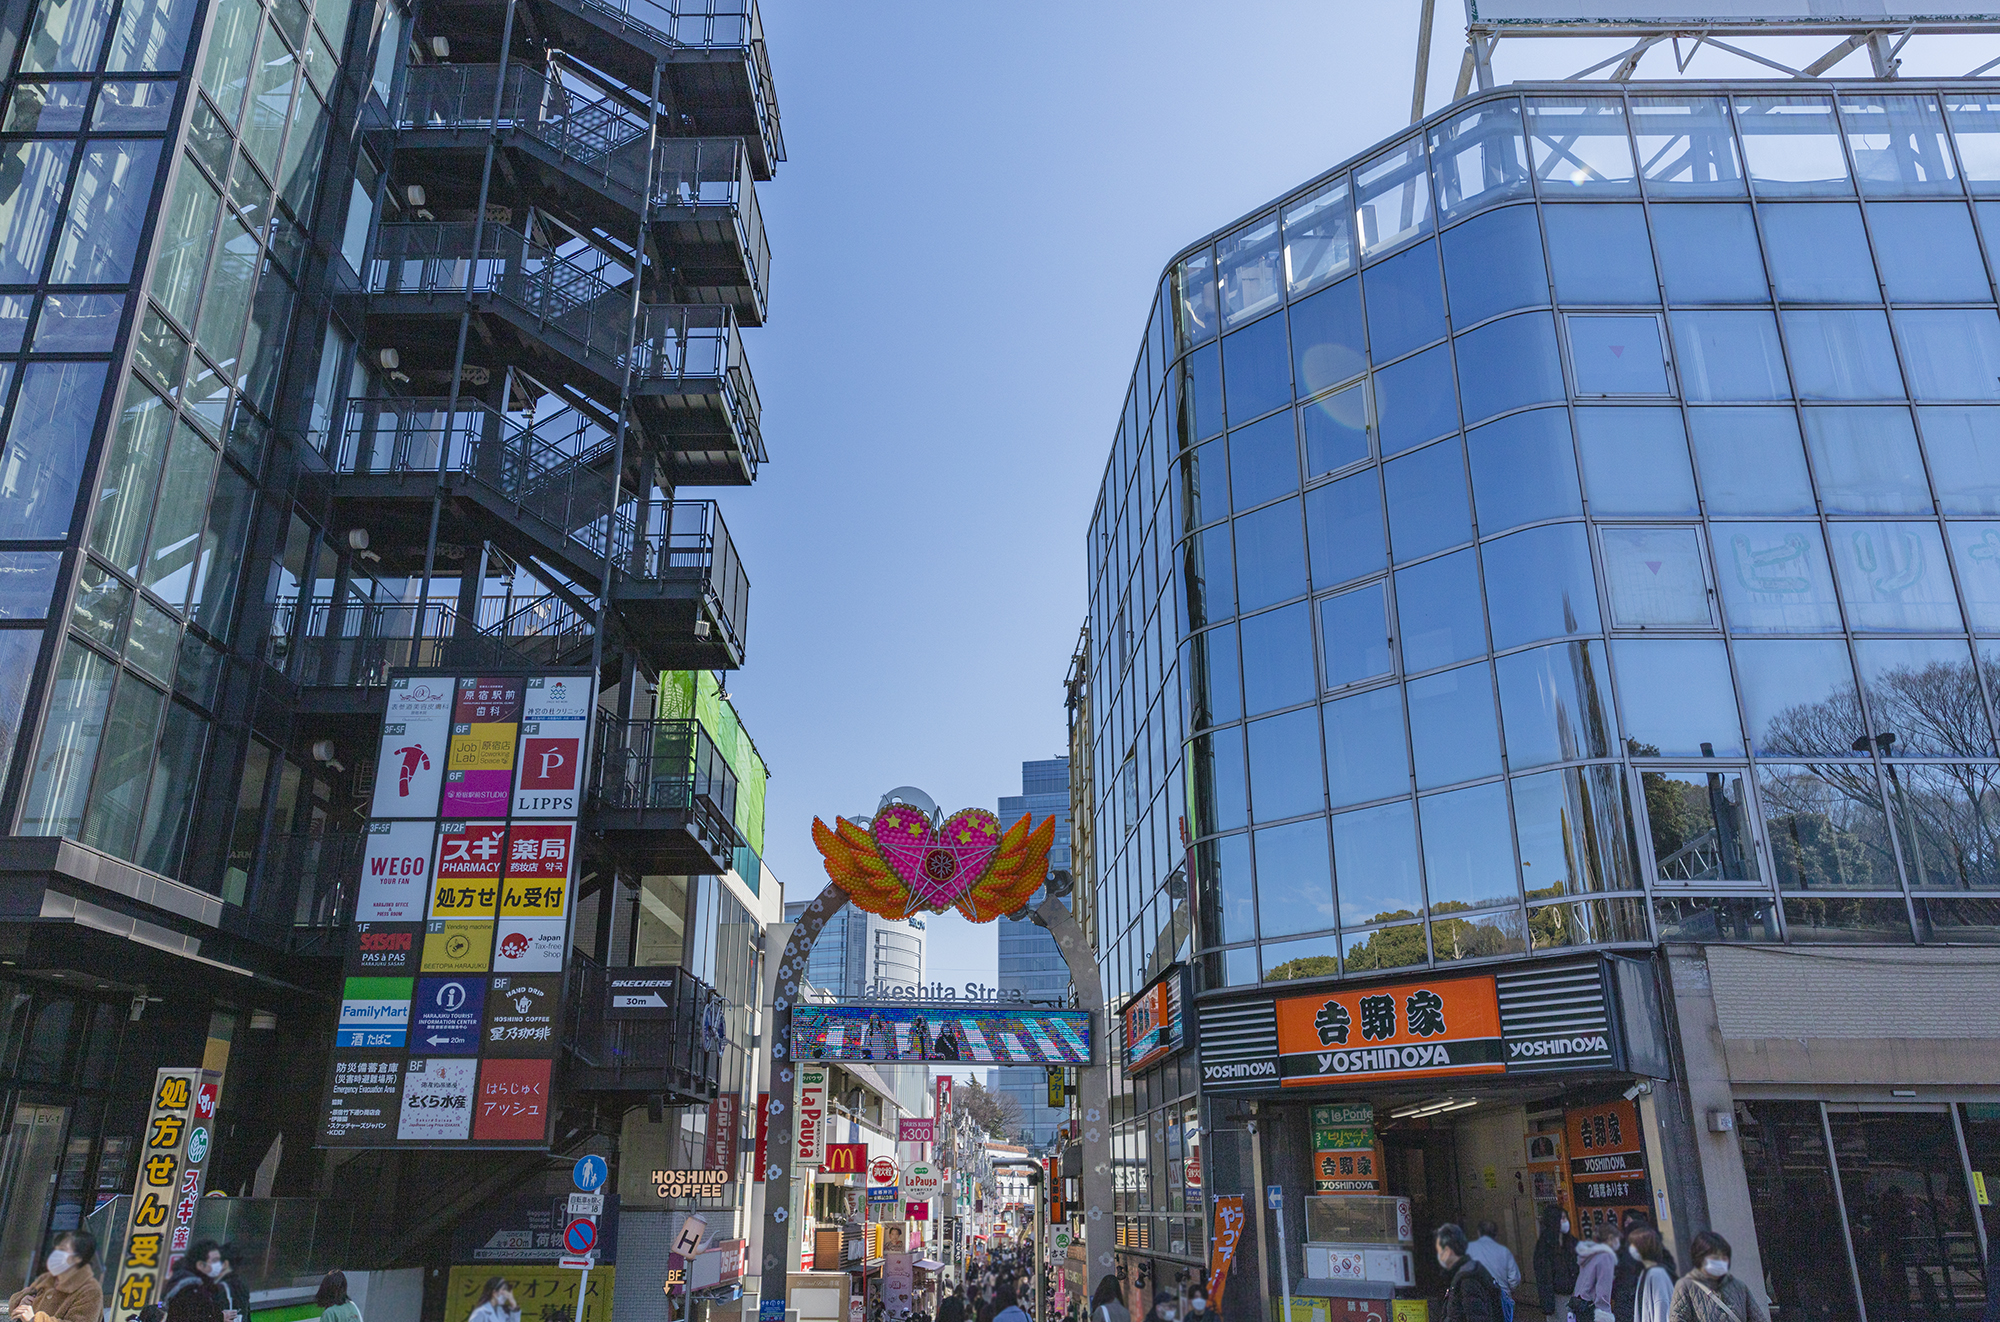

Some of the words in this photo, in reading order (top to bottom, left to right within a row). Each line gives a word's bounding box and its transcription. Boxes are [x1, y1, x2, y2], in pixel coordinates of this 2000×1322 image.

[394, 679, 406, 688] 7F
[462, 679, 474, 687] 7F
[530, 679, 542, 687] 7F
[464, 690, 515, 700] 原宿駅前
[476, 706, 500, 716] 歯科
[455, 725, 469, 733] 6F
[524, 725, 537, 733] 4F
[456, 743, 477, 752] Job
[481, 741, 510, 751] 原宿店
[455, 753, 475, 763] Lab
[480, 757, 500, 765] Space
[449, 772, 463, 780] 6F
[518, 797, 573, 810] LIPPS
[440, 823, 465, 833] 1F/2F
[371, 857, 425, 876] WEGO
[442, 862, 501, 872] PHARMACY
[545, 862, 564, 872] 약국
[436, 887, 563, 908] 処方せん受付
[357, 924, 370, 932] 1F
[429, 923, 442, 931] 1F
[446, 923, 468, 931] Vending
[538, 934, 561, 942] Japan
[362, 953, 380, 961] PAS
[388, 953, 406, 961] PAS
[543, 951, 561, 959] Shop
[494, 979, 507, 988] BF
[505, 987, 526, 998] HAND
[528, 987, 544, 997] DRIP
[853, 979, 956, 1001] Takeshita
[965, 982, 1028, 1001] Street
[342, 1006, 408, 1020] FamilyMart
[1314, 989, 1448, 1047] 吉野家
[490, 1026, 552, 1041] 星乃珈琲
[351, 1032, 364, 1047] 酒
[366, 1033, 391, 1046] たばこ
[1510, 1034, 1608, 1058] YOSHINOYA
[1317, 1045, 1450, 1073] YOSHINOYA
[336, 1062, 399, 1073] 防災備蓄倉庫
[409, 1061, 423, 1071] BF
[1203, 1060, 1277, 1081] YOSHINOYA
[333, 1085, 358, 1094] Emergency
[359, 1085, 383, 1093] Evacuation
[384, 1085, 396, 1093] Area
[486, 1082, 540, 1095] はらじゅく
[196, 1083, 216, 1118] くすり
[408, 1095, 466, 1108] さくら水産
[801, 1088, 822, 1106] La
[484, 1102, 539, 1116] アッシュ
[1343, 1108, 1373, 1120] Ponte
[37, 1114, 60, 1123] EV-1
[902, 1128, 930, 1140] ¥300
[1580, 1111, 1623, 1149] 吉野家
[1321, 1156, 1373, 1176] 吉野家
[1584, 1156, 1626, 1171] YOSHINOYA
[874, 1167, 892, 1176] 消火栓
[651, 1170, 729, 1184] HOSHINO
[905, 1176, 914, 1186] La
[1322, 1181, 1373, 1190] YOSHINOYA
[1587, 1182, 1630, 1198] 2階席あります
[120, 1077, 190, 1309] 処方せん受付
[657, 1184, 722, 1198] COFFEE
[570, 1196, 601, 1205] 自転車を除く
[668, 1270, 682, 1280] BF
[464, 1279, 599, 1298] シアオフィス
[1280, 1298, 1320, 1307] コンロッカー
